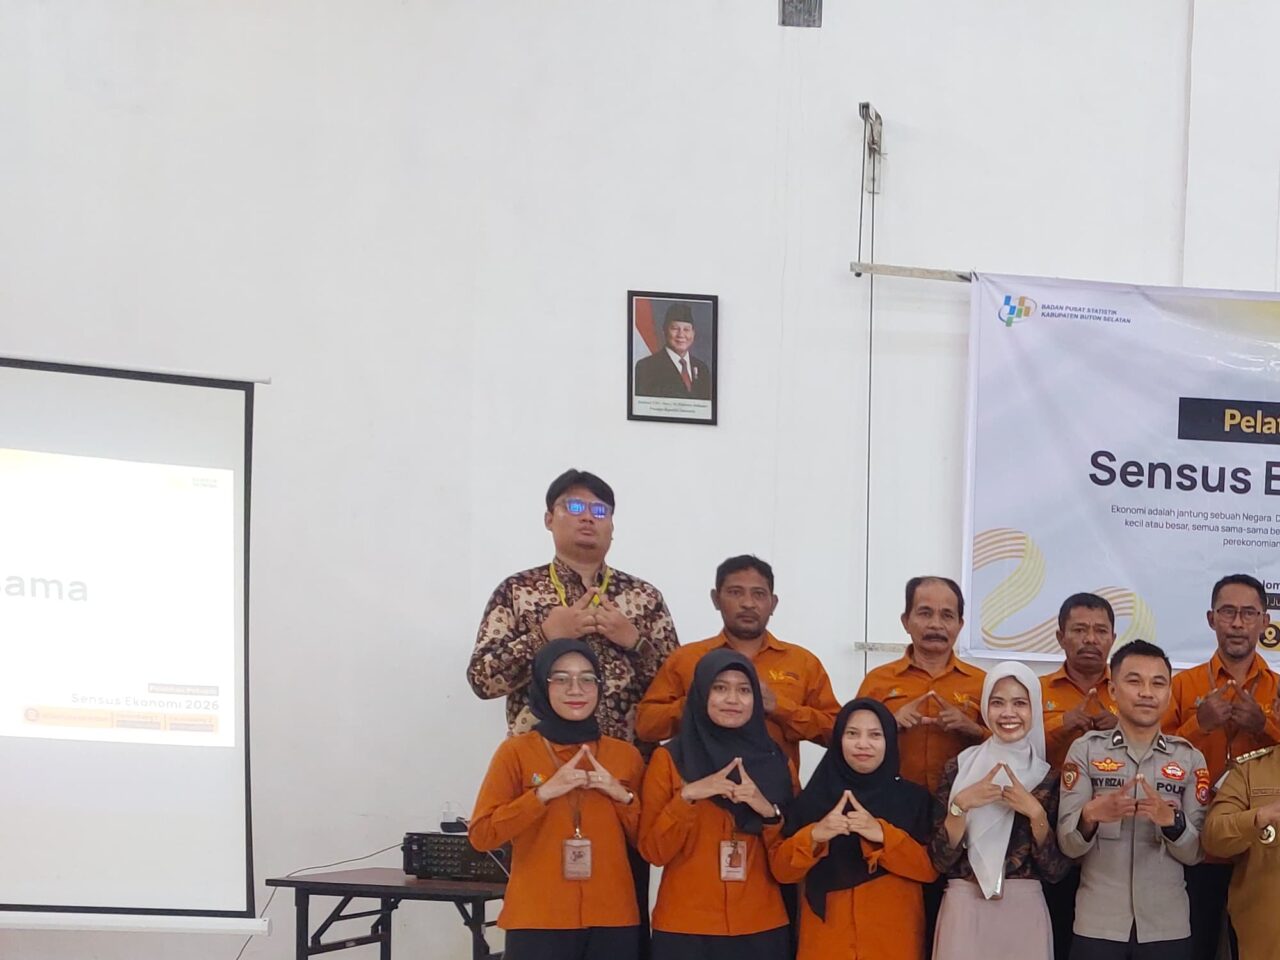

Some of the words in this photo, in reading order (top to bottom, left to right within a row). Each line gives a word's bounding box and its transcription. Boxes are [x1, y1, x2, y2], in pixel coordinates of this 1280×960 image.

[1041, 311, 1079, 319] KABUPATEN
[1103, 316, 1131, 324] SELATAN
[1087, 307, 1117, 315] STATISTIK
[1088, 449, 1253, 496] Sensus
[1111, 504, 1146, 516] Ekonomi
[1147, 507, 1175, 517] adalah
[1175, 509, 1209, 520] jantung
[1209, 511, 1241, 521] sebuah
[1124, 518, 1144, 528] kecil
[1144, 520, 1164, 529] atau
[1191, 524, 1220, 533] semua
[1220, 525, 1269, 535] sama-sama
[0, 575, 88, 603] ama
[72, 693, 121, 706] Sensus
[124, 696, 182, 709] Ekonomi
[185, 699, 220, 711] 2026
